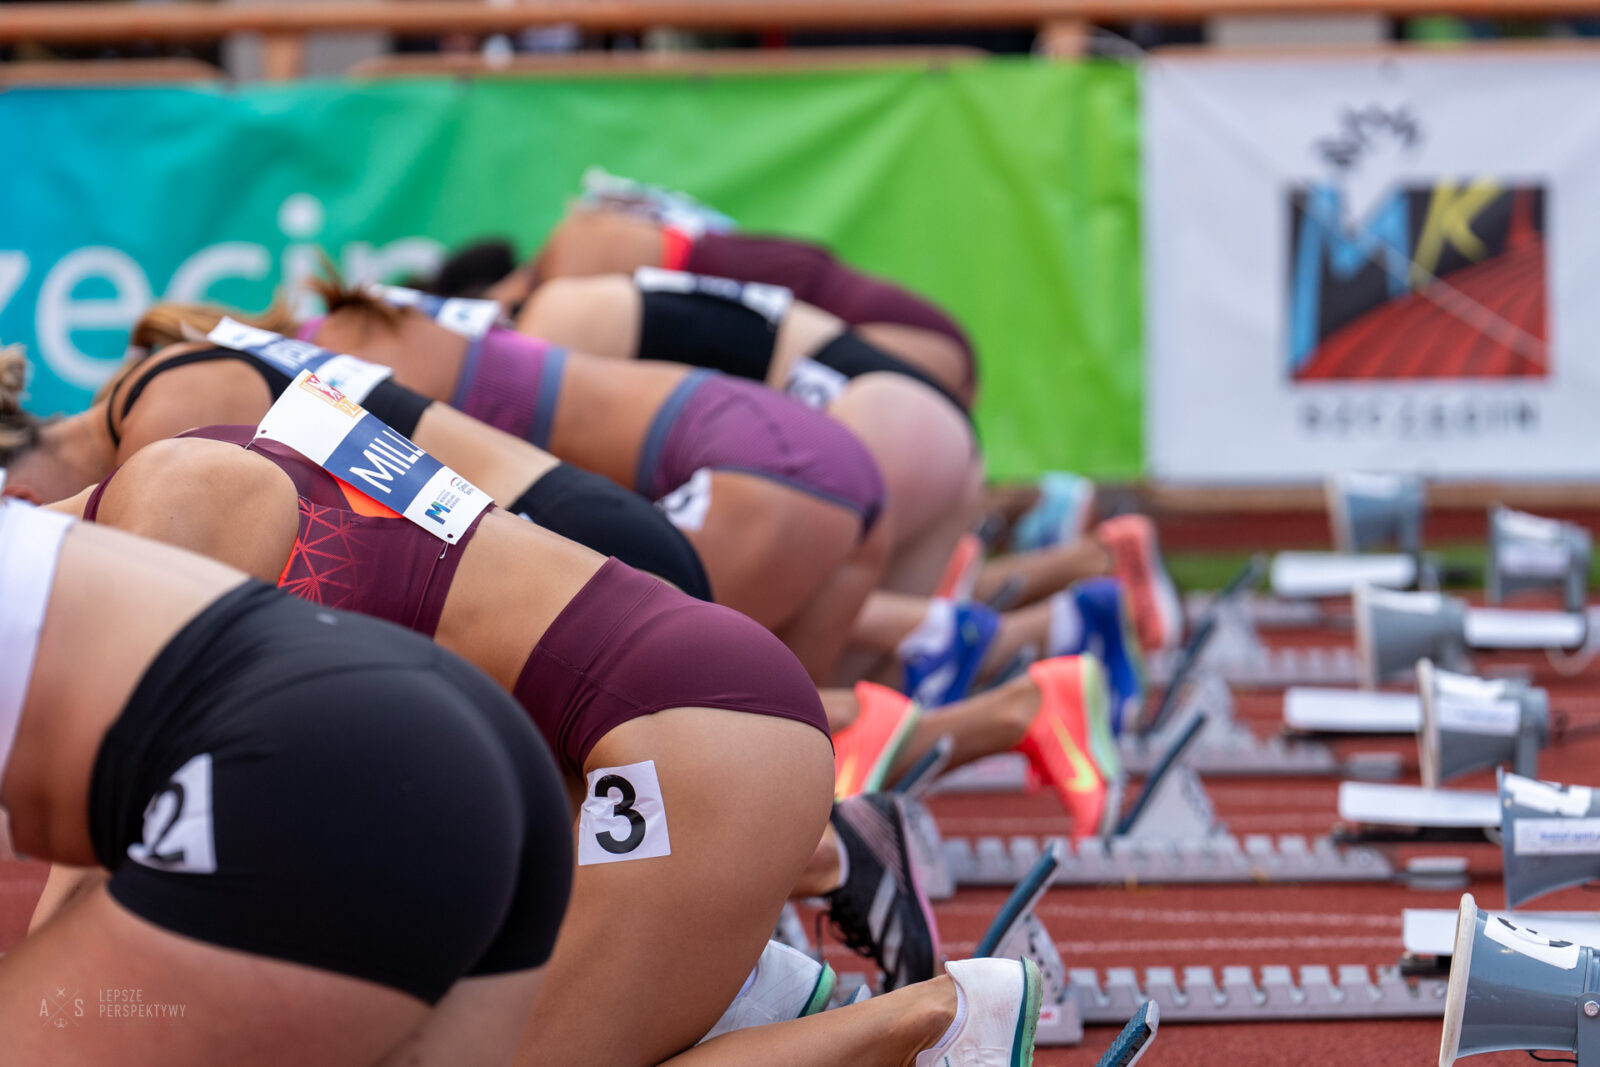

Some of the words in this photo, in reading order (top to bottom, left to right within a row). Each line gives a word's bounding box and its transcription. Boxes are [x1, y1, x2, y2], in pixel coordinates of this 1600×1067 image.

[0, 192, 447, 392] eci
[349, 425, 426, 495] MILL
[147, 780, 187, 863] 2
[594, 774, 647, 855] 3
